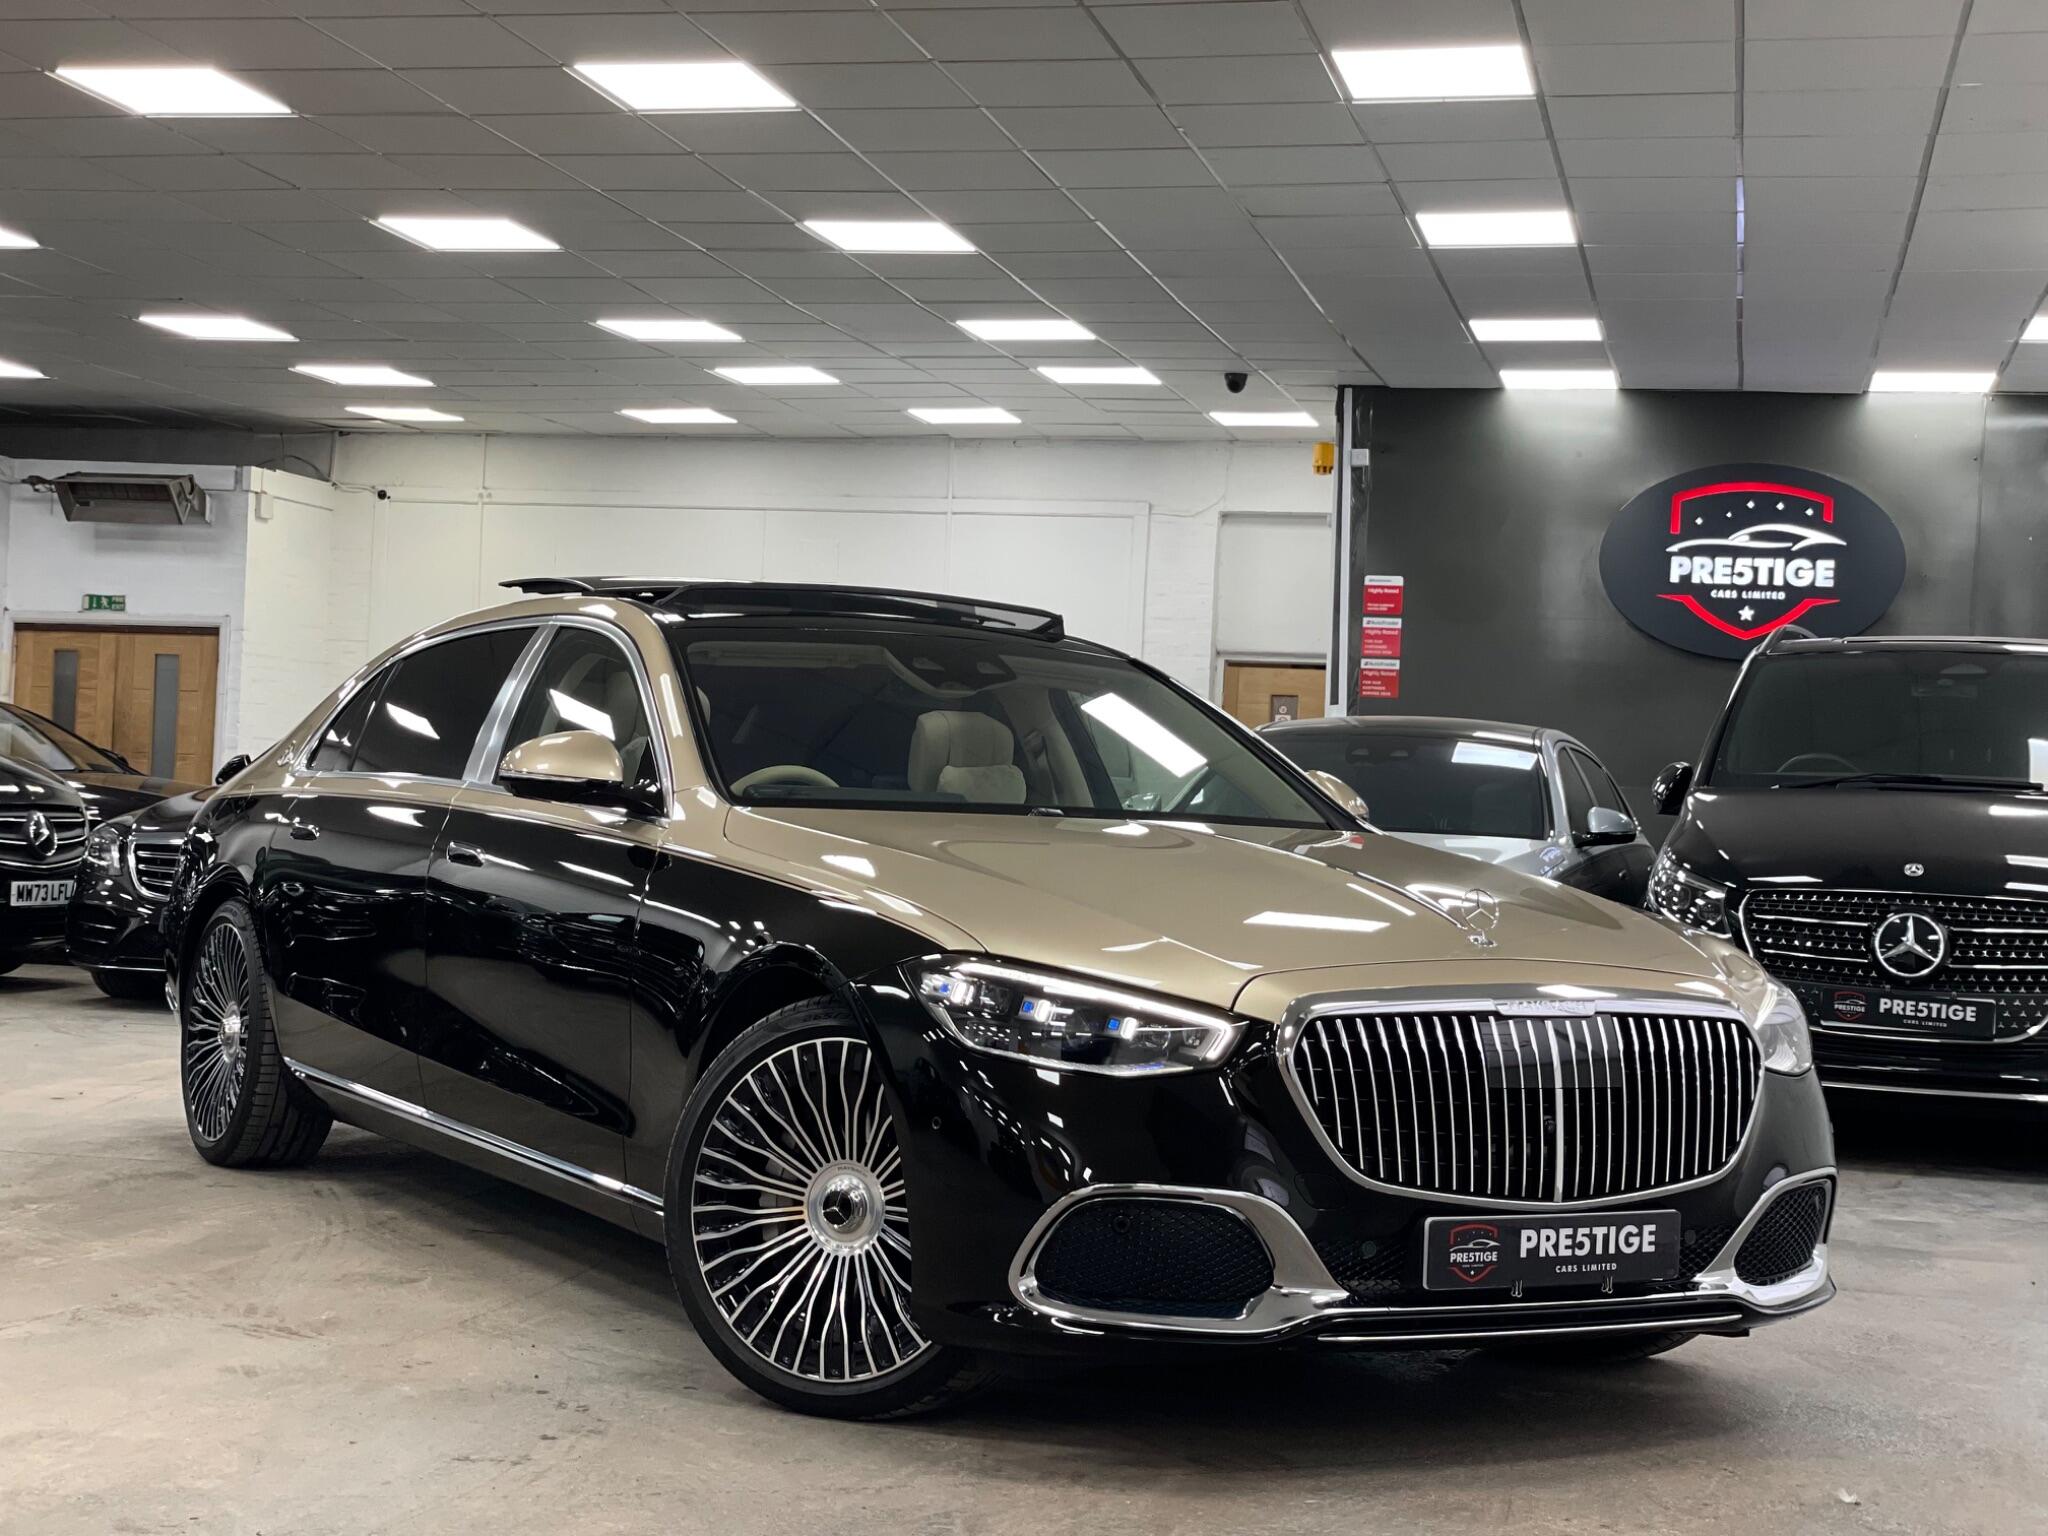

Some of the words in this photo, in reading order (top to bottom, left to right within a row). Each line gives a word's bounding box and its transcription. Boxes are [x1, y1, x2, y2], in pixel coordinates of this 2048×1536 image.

[1710, 589, 1738, 599] CARS
[1741, 590, 1786, 600] LIMITED
[1555, 1264, 1578, 1273] CARS
[1582, 1262, 1618, 1272] LIMITED
